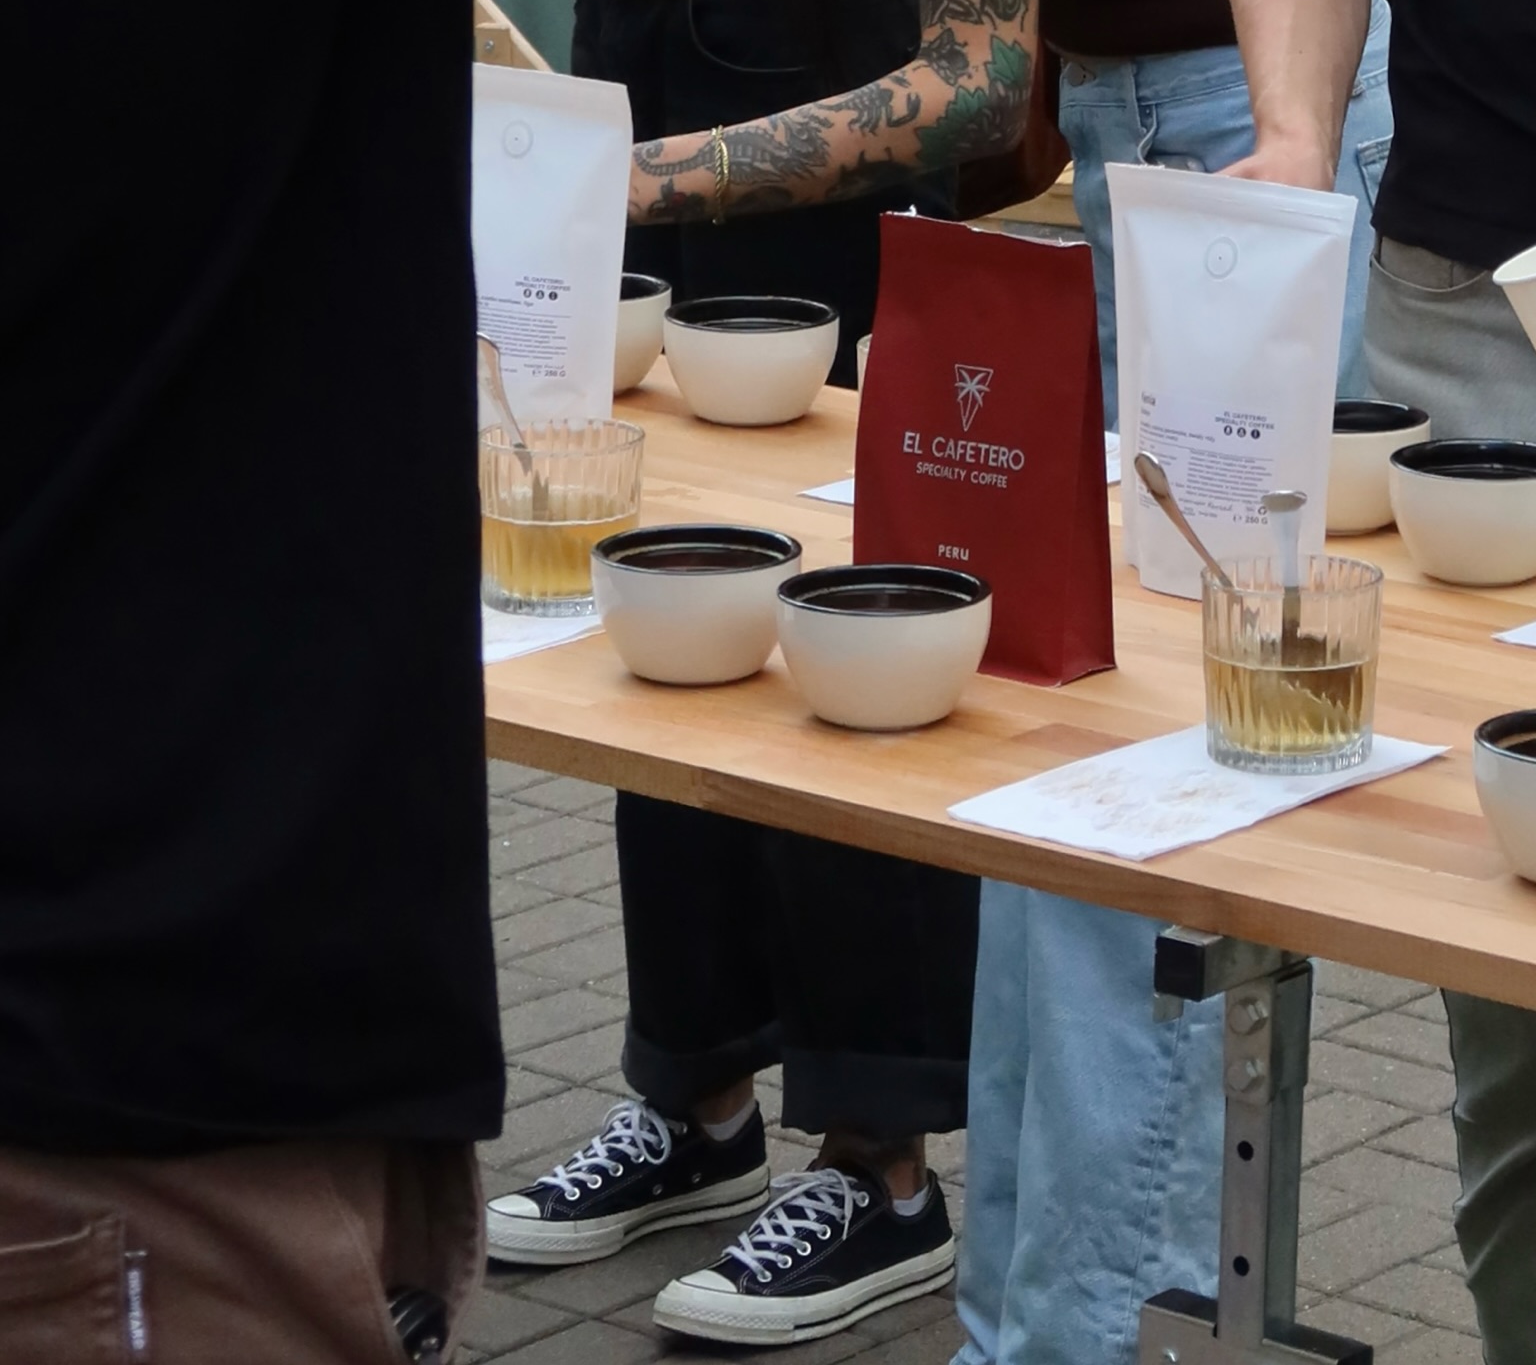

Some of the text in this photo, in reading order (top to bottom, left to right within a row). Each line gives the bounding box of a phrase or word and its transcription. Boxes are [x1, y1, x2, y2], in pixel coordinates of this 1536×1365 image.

[902, 431, 1025, 471] EL CAFETERO
[916, 461, 1009, 488] SPECIALTY COFFEE
[937, 544, 970, 561] PERU
